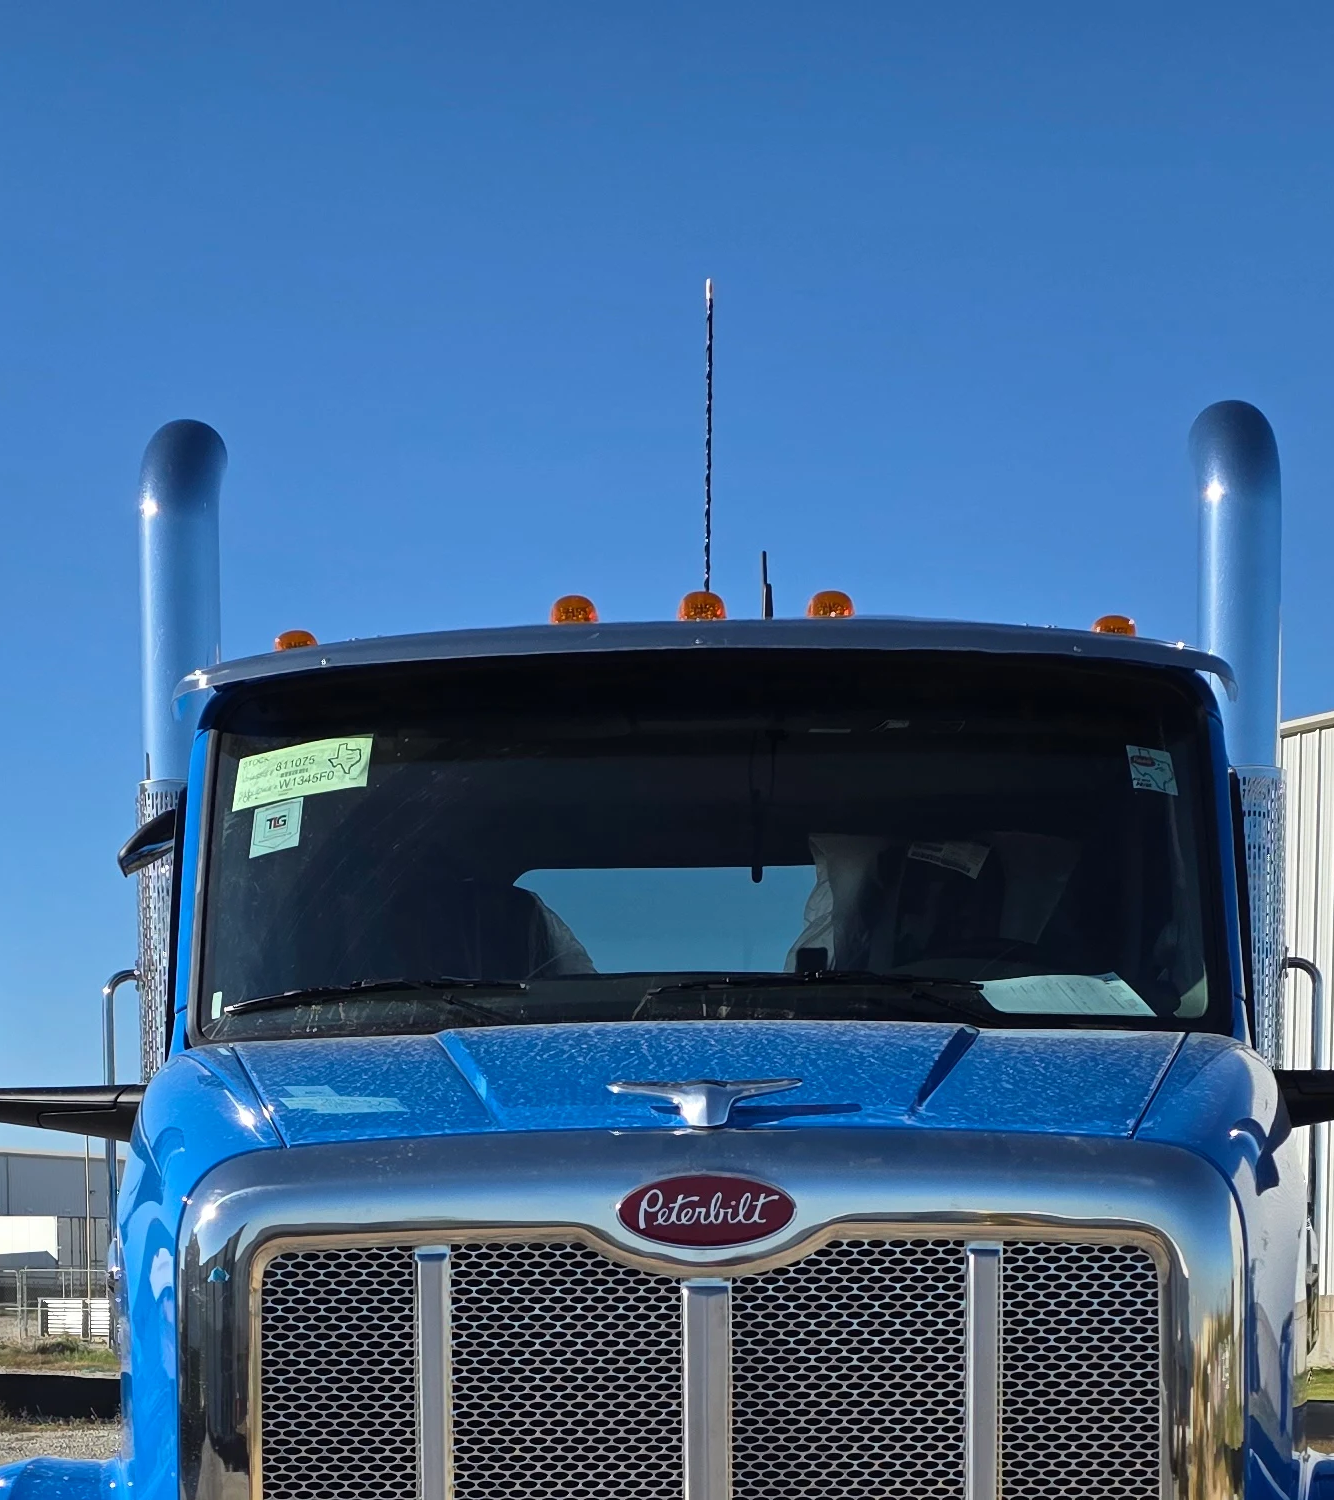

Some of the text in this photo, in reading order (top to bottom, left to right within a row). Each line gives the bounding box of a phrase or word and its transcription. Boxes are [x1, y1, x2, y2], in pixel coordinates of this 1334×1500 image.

[275, 754, 316, 772] 811075
[266, 814, 288, 830] TLG
[638, 1188, 780, 1230] Peterbilt
